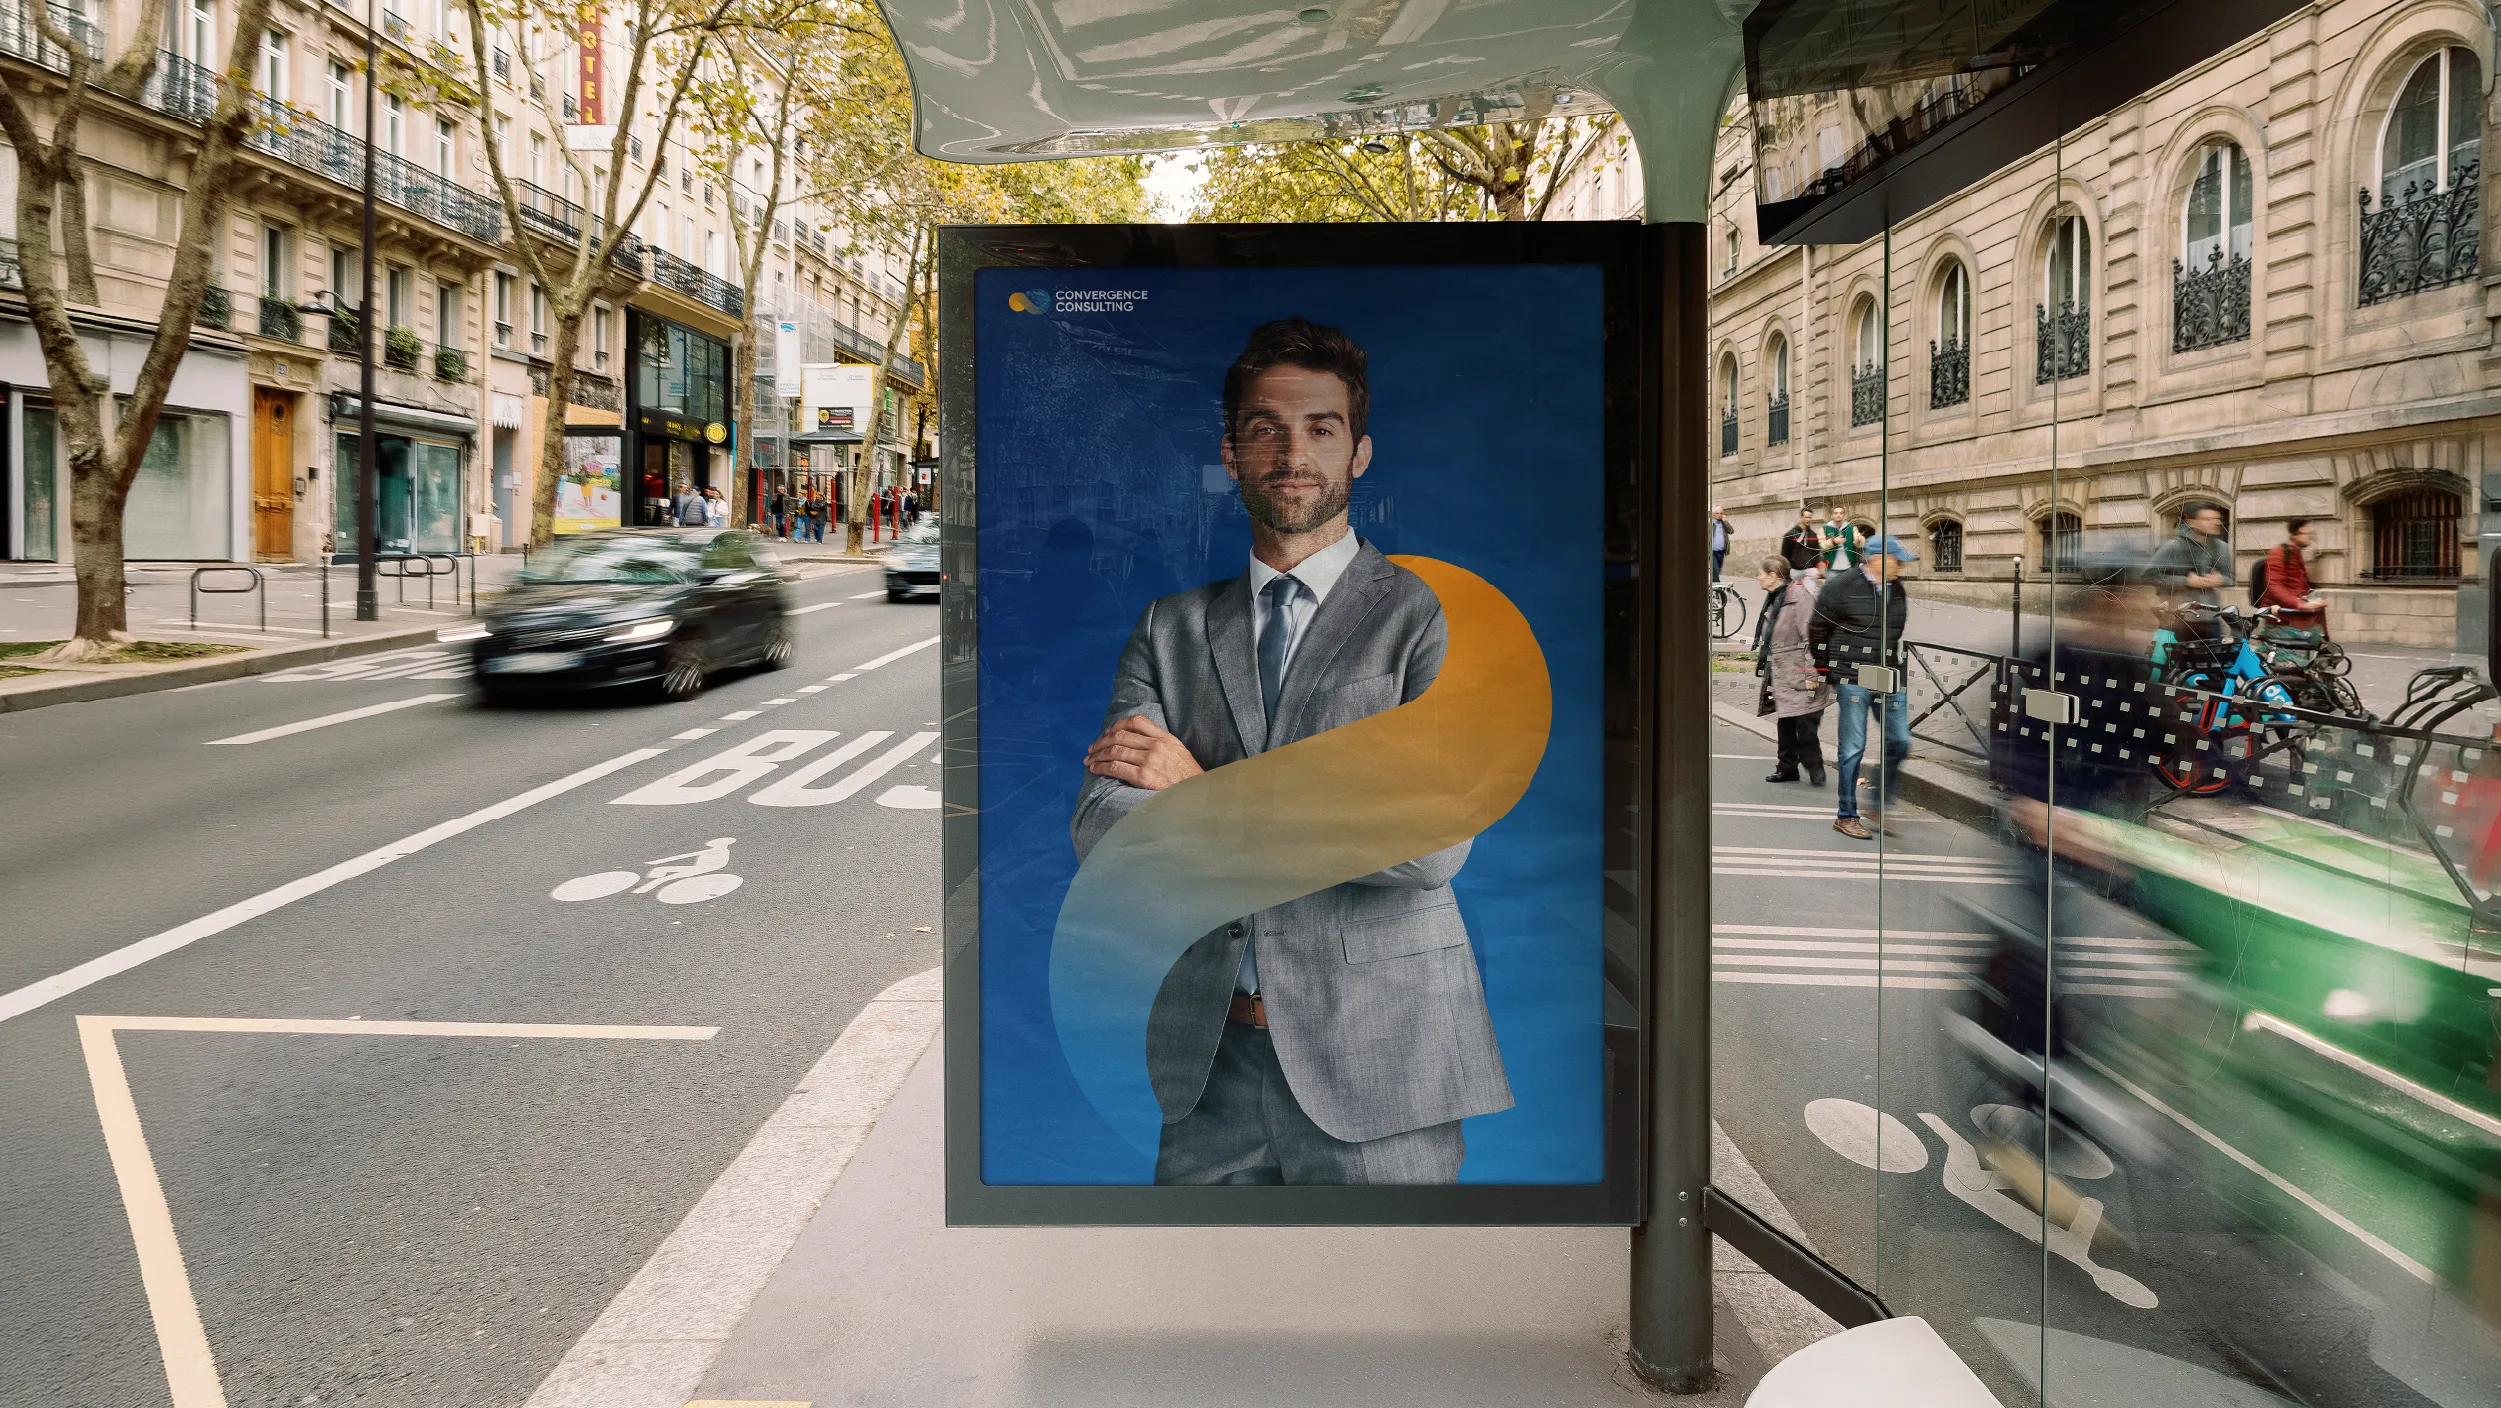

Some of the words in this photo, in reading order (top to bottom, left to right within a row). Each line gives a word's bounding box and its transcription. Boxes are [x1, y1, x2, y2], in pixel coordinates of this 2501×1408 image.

[581, 5, 597, 124] HOTEL
[1055, 290, 1149, 300] CONVERGENCE
[1055, 301, 1134, 312] CONSULTING
